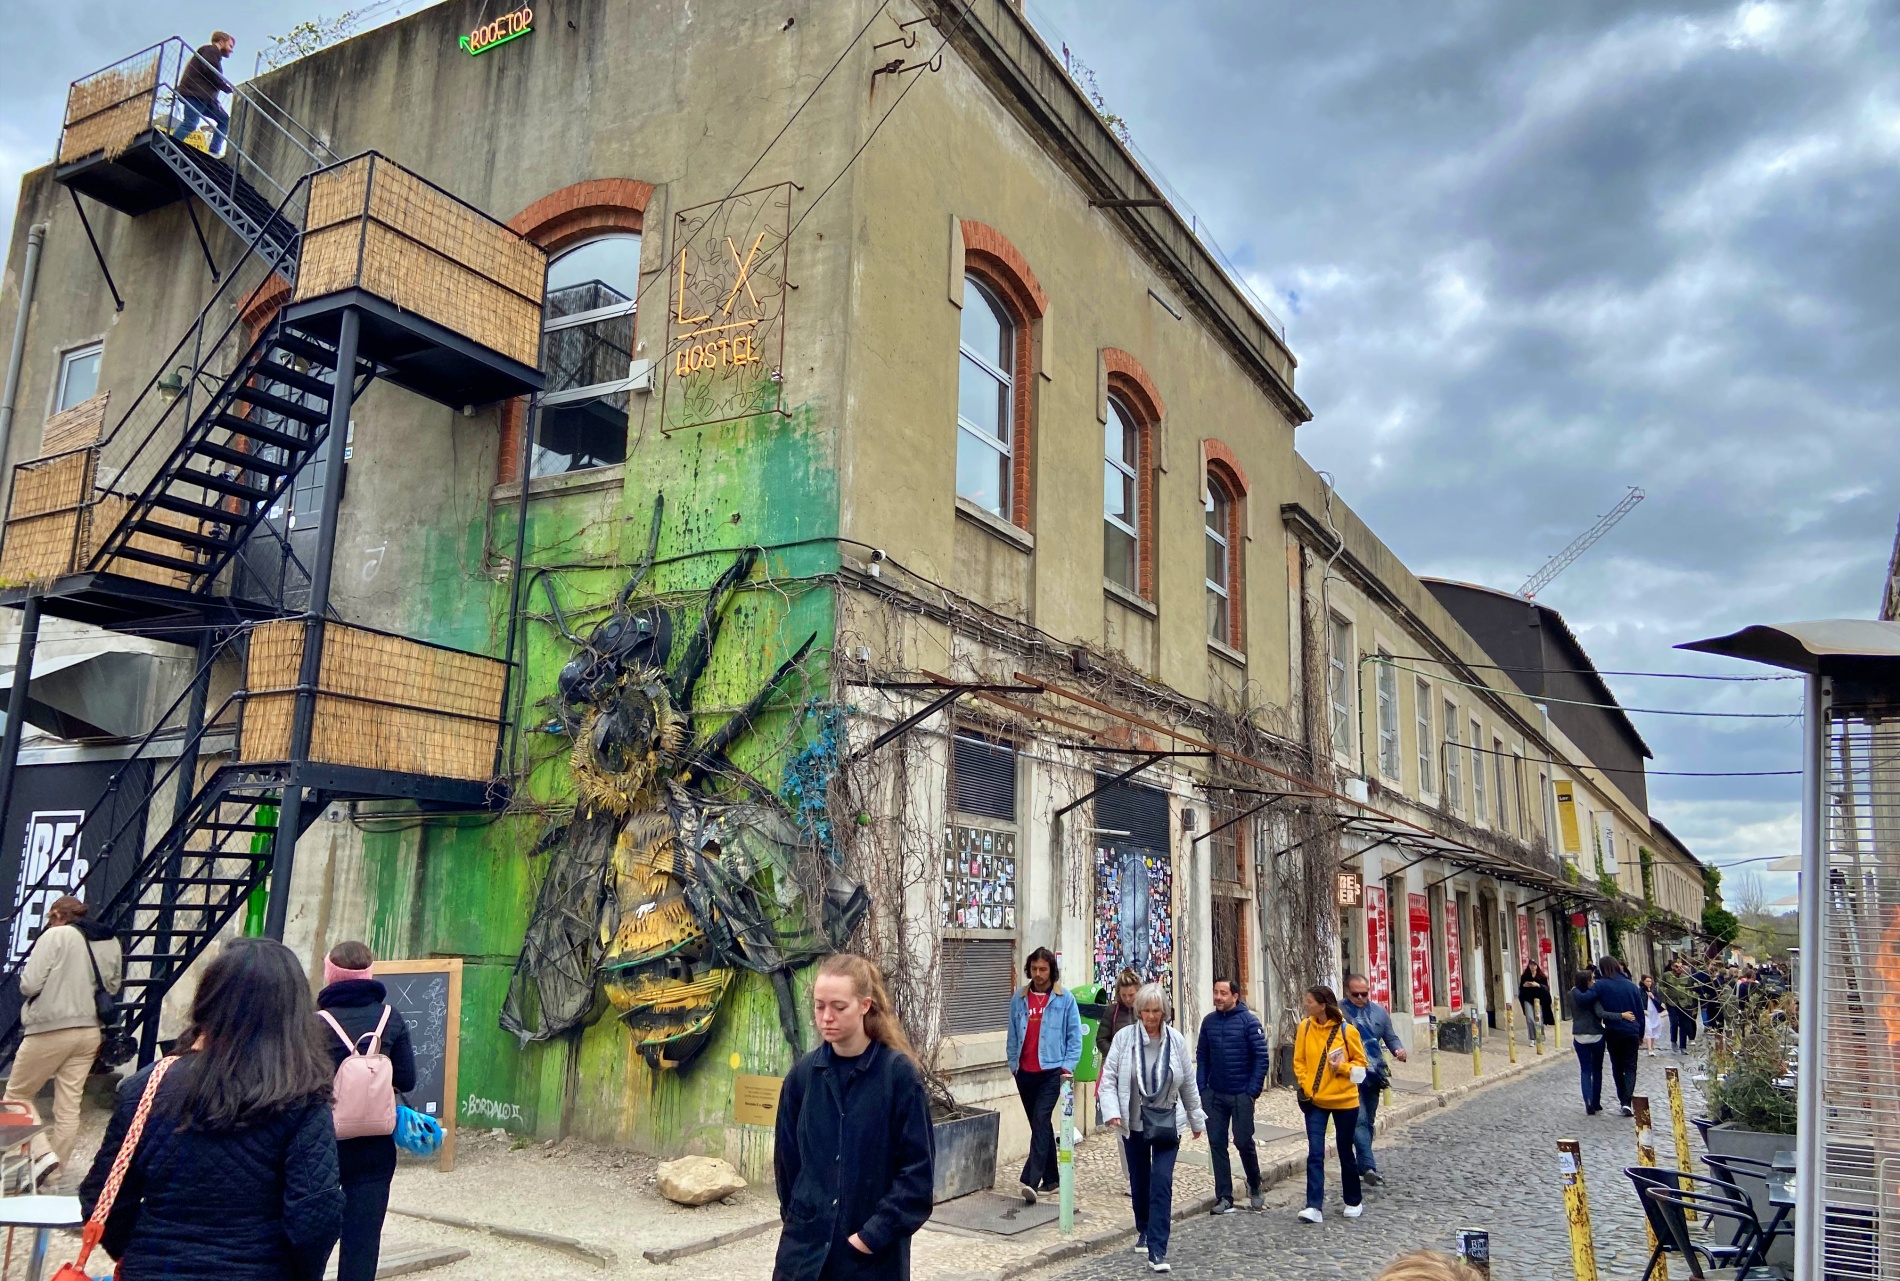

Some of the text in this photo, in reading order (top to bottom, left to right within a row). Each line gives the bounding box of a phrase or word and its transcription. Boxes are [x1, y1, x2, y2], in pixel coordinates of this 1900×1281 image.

[471, 8, 533, 51] ROOFTOP
[678, 232, 765, 323] LX
[676, 336, 759, 375] HOSTEL
